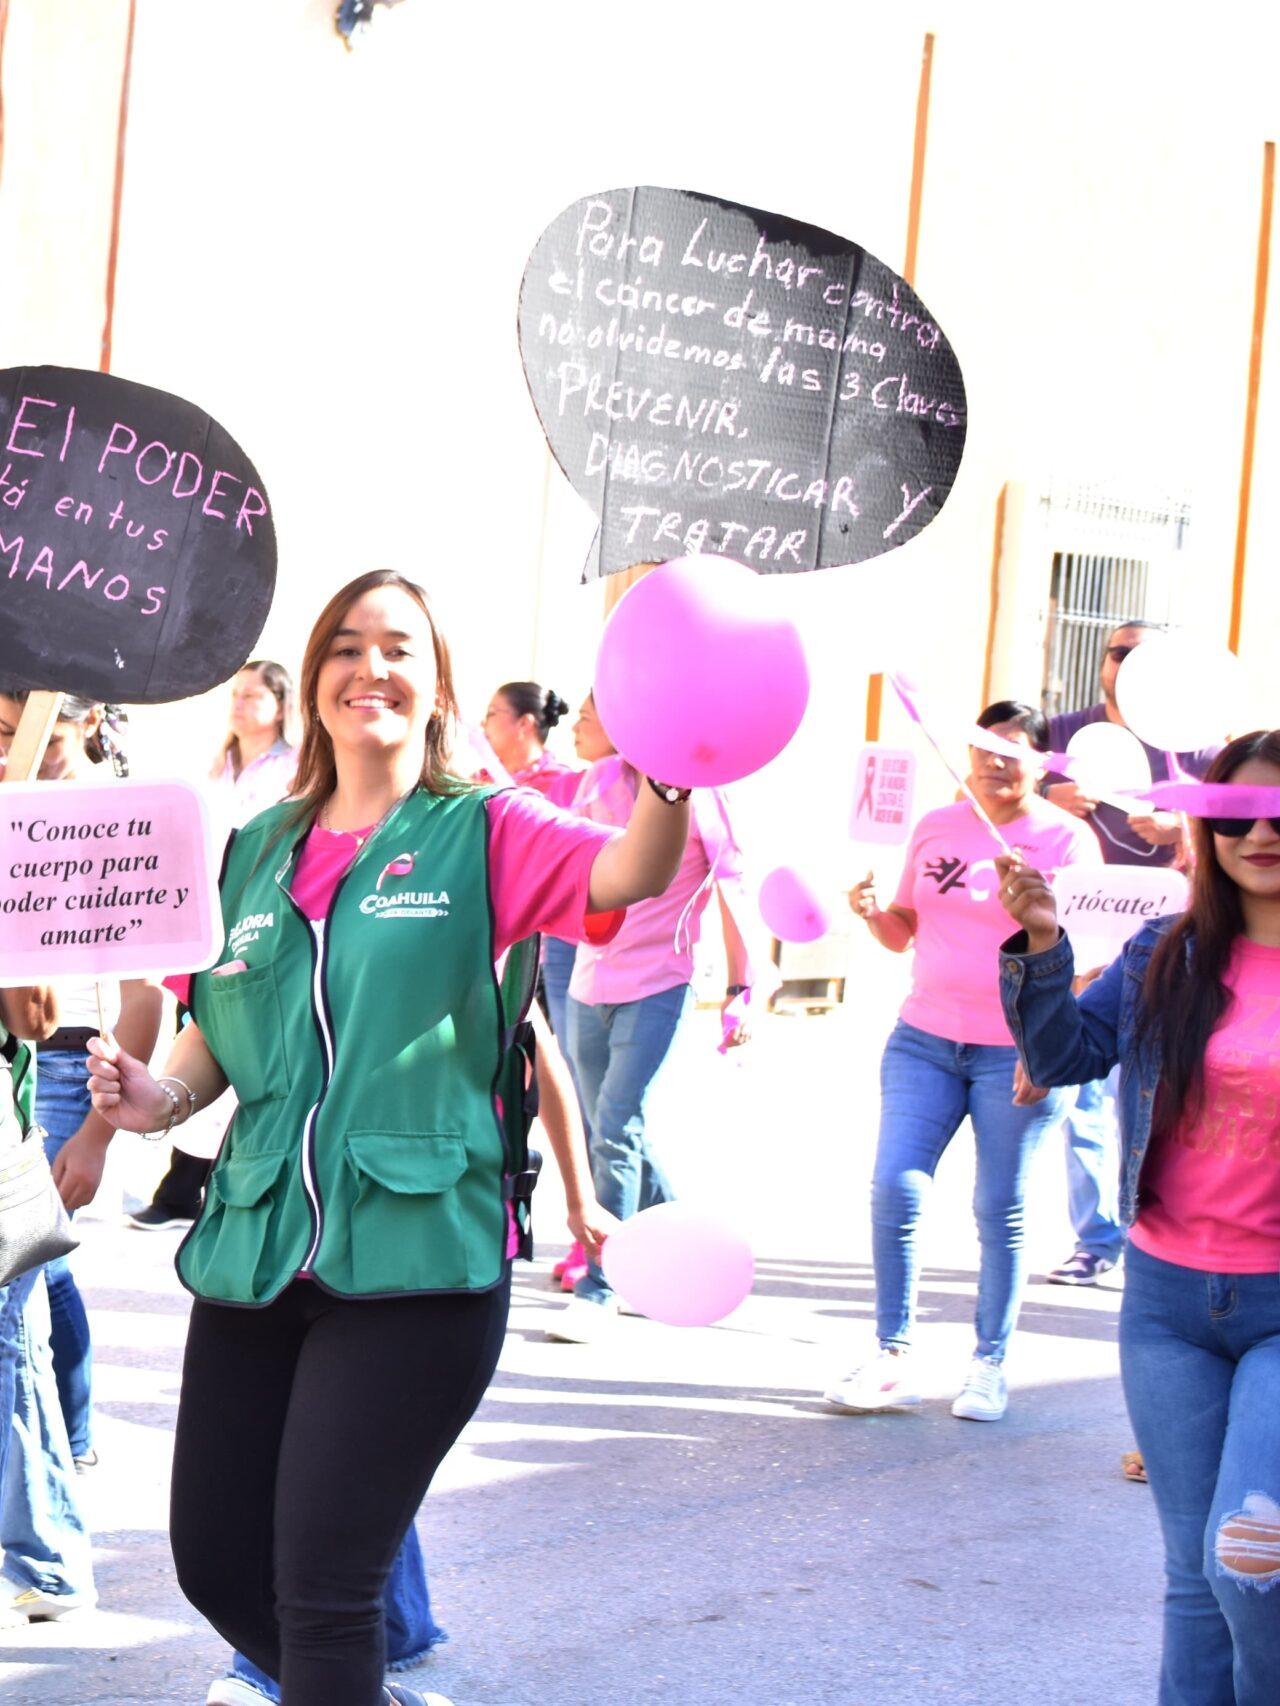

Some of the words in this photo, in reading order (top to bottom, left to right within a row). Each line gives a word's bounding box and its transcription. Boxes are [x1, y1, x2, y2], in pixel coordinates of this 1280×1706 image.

[576, 200, 664, 267] Para
[680, 217, 824, 290] Luchar
[823, 282, 940, 352] contra
[595, 276, 716, 316] cáncer
[723, 288, 773, 335] de
[783, 317, 887, 362] mama
[586, 318, 746, 371] olvidemos
[760, 346, 822, 391] las
[839, 372, 861, 401] 3
[557, 361, 749, 438] PREVENIR,
[5, 395, 76, 463] El
[97, 422, 268, 537] PODER
[584, 431, 860, 518] DIAGNOSTICAR
[54, 495, 94, 526] en
[108, 499, 170, 552] tus
[620, 505, 808, 564] TRATAR
[10, 818, 120, 843] "Conoce
[127, 817, 153, 837] tu
[9, 856, 93, 883] cuerpo
[100, 853, 159, 880] para
[64, 885, 168, 911] cuidarte
[173, 885, 189, 908] y
[359, 890, 451, 915] COAHUILA
[1064, 889, 1167, 917] ¡tócate!
